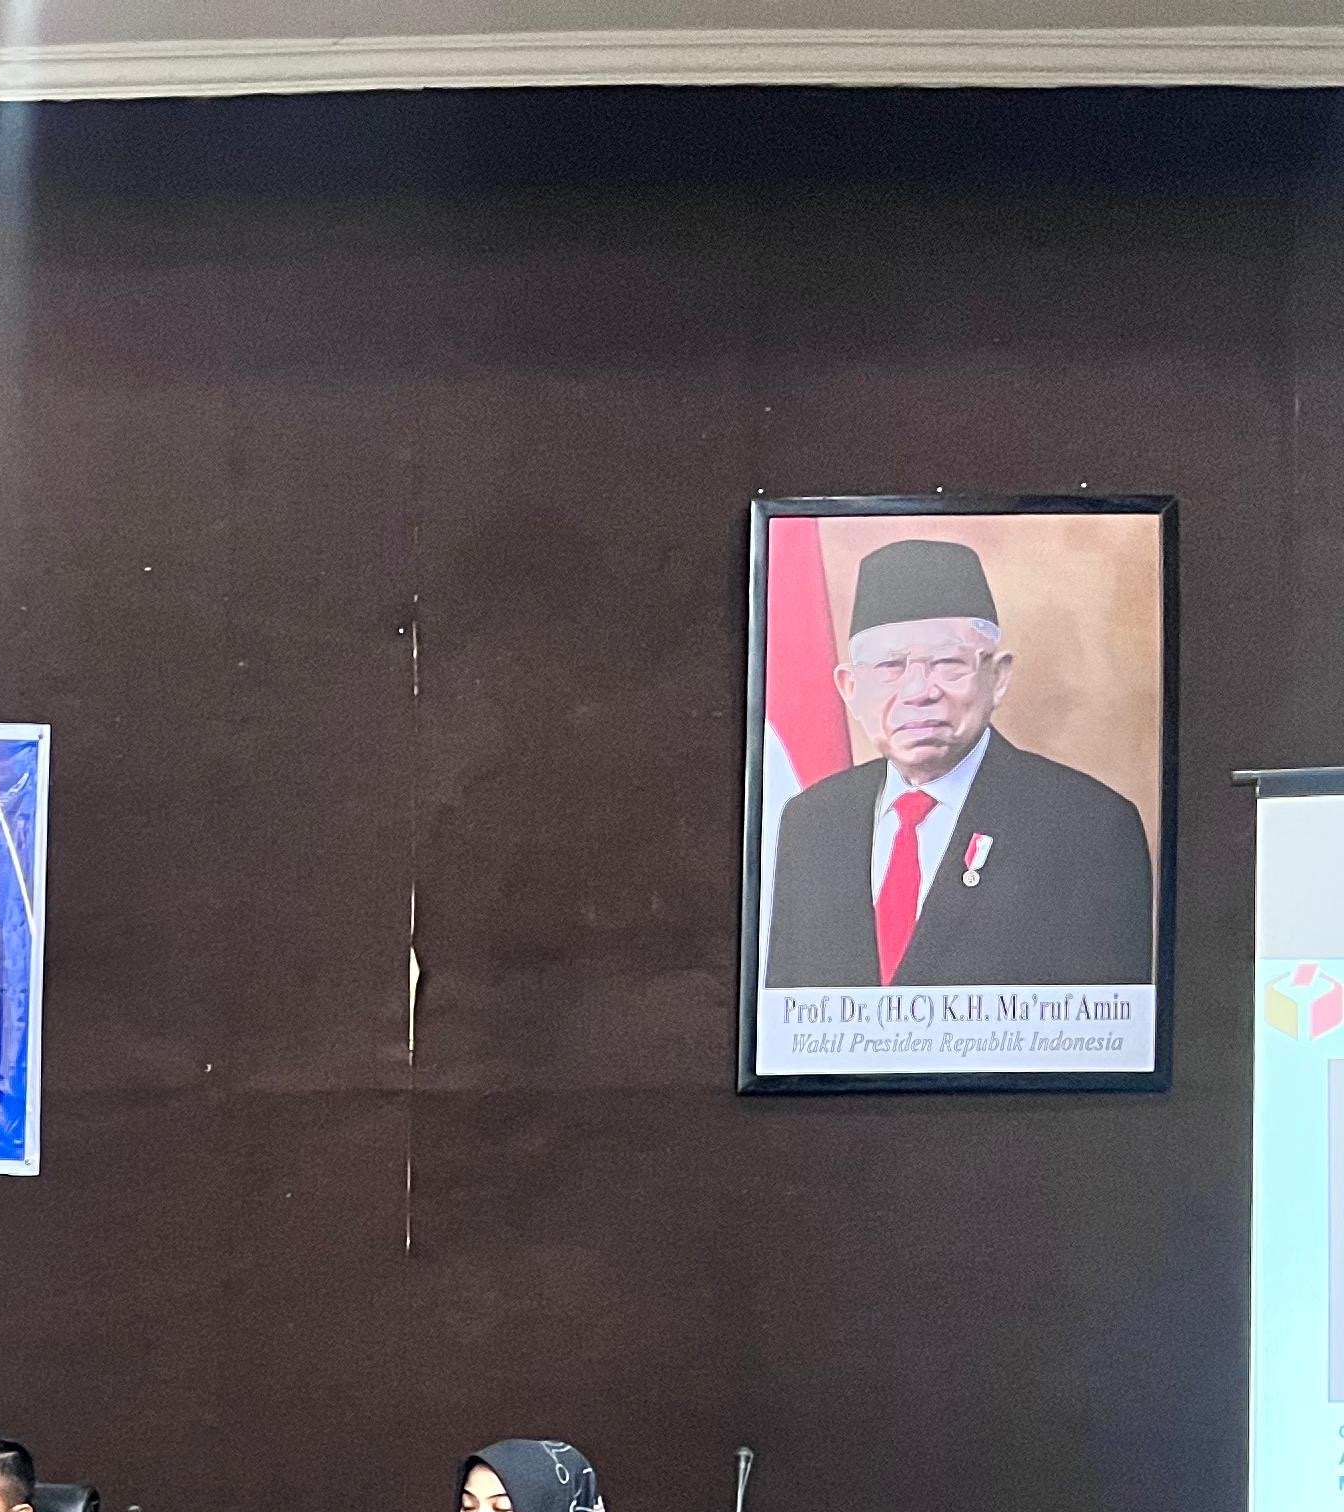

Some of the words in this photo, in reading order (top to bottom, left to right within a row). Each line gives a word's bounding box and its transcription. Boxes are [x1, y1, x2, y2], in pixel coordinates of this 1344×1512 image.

[783, 995, 833, 1023] Prof.
[840, 995, 871, 1023] Dr.
[876, 994, 935, 1029] (H.C)
[942, 994, 990, 1022] K.H.
[996, 993, 1074, 1021] Ma'ruf
[1076, 993, 1131, 1021] Amin
[792, 1032, 845, 1054] Wakil
[849, 1031, 933, 1053] Presiden
[939, 1030, 1025, 1058] Republik
[1029, 1030, 1124, 1052] Indonesia
